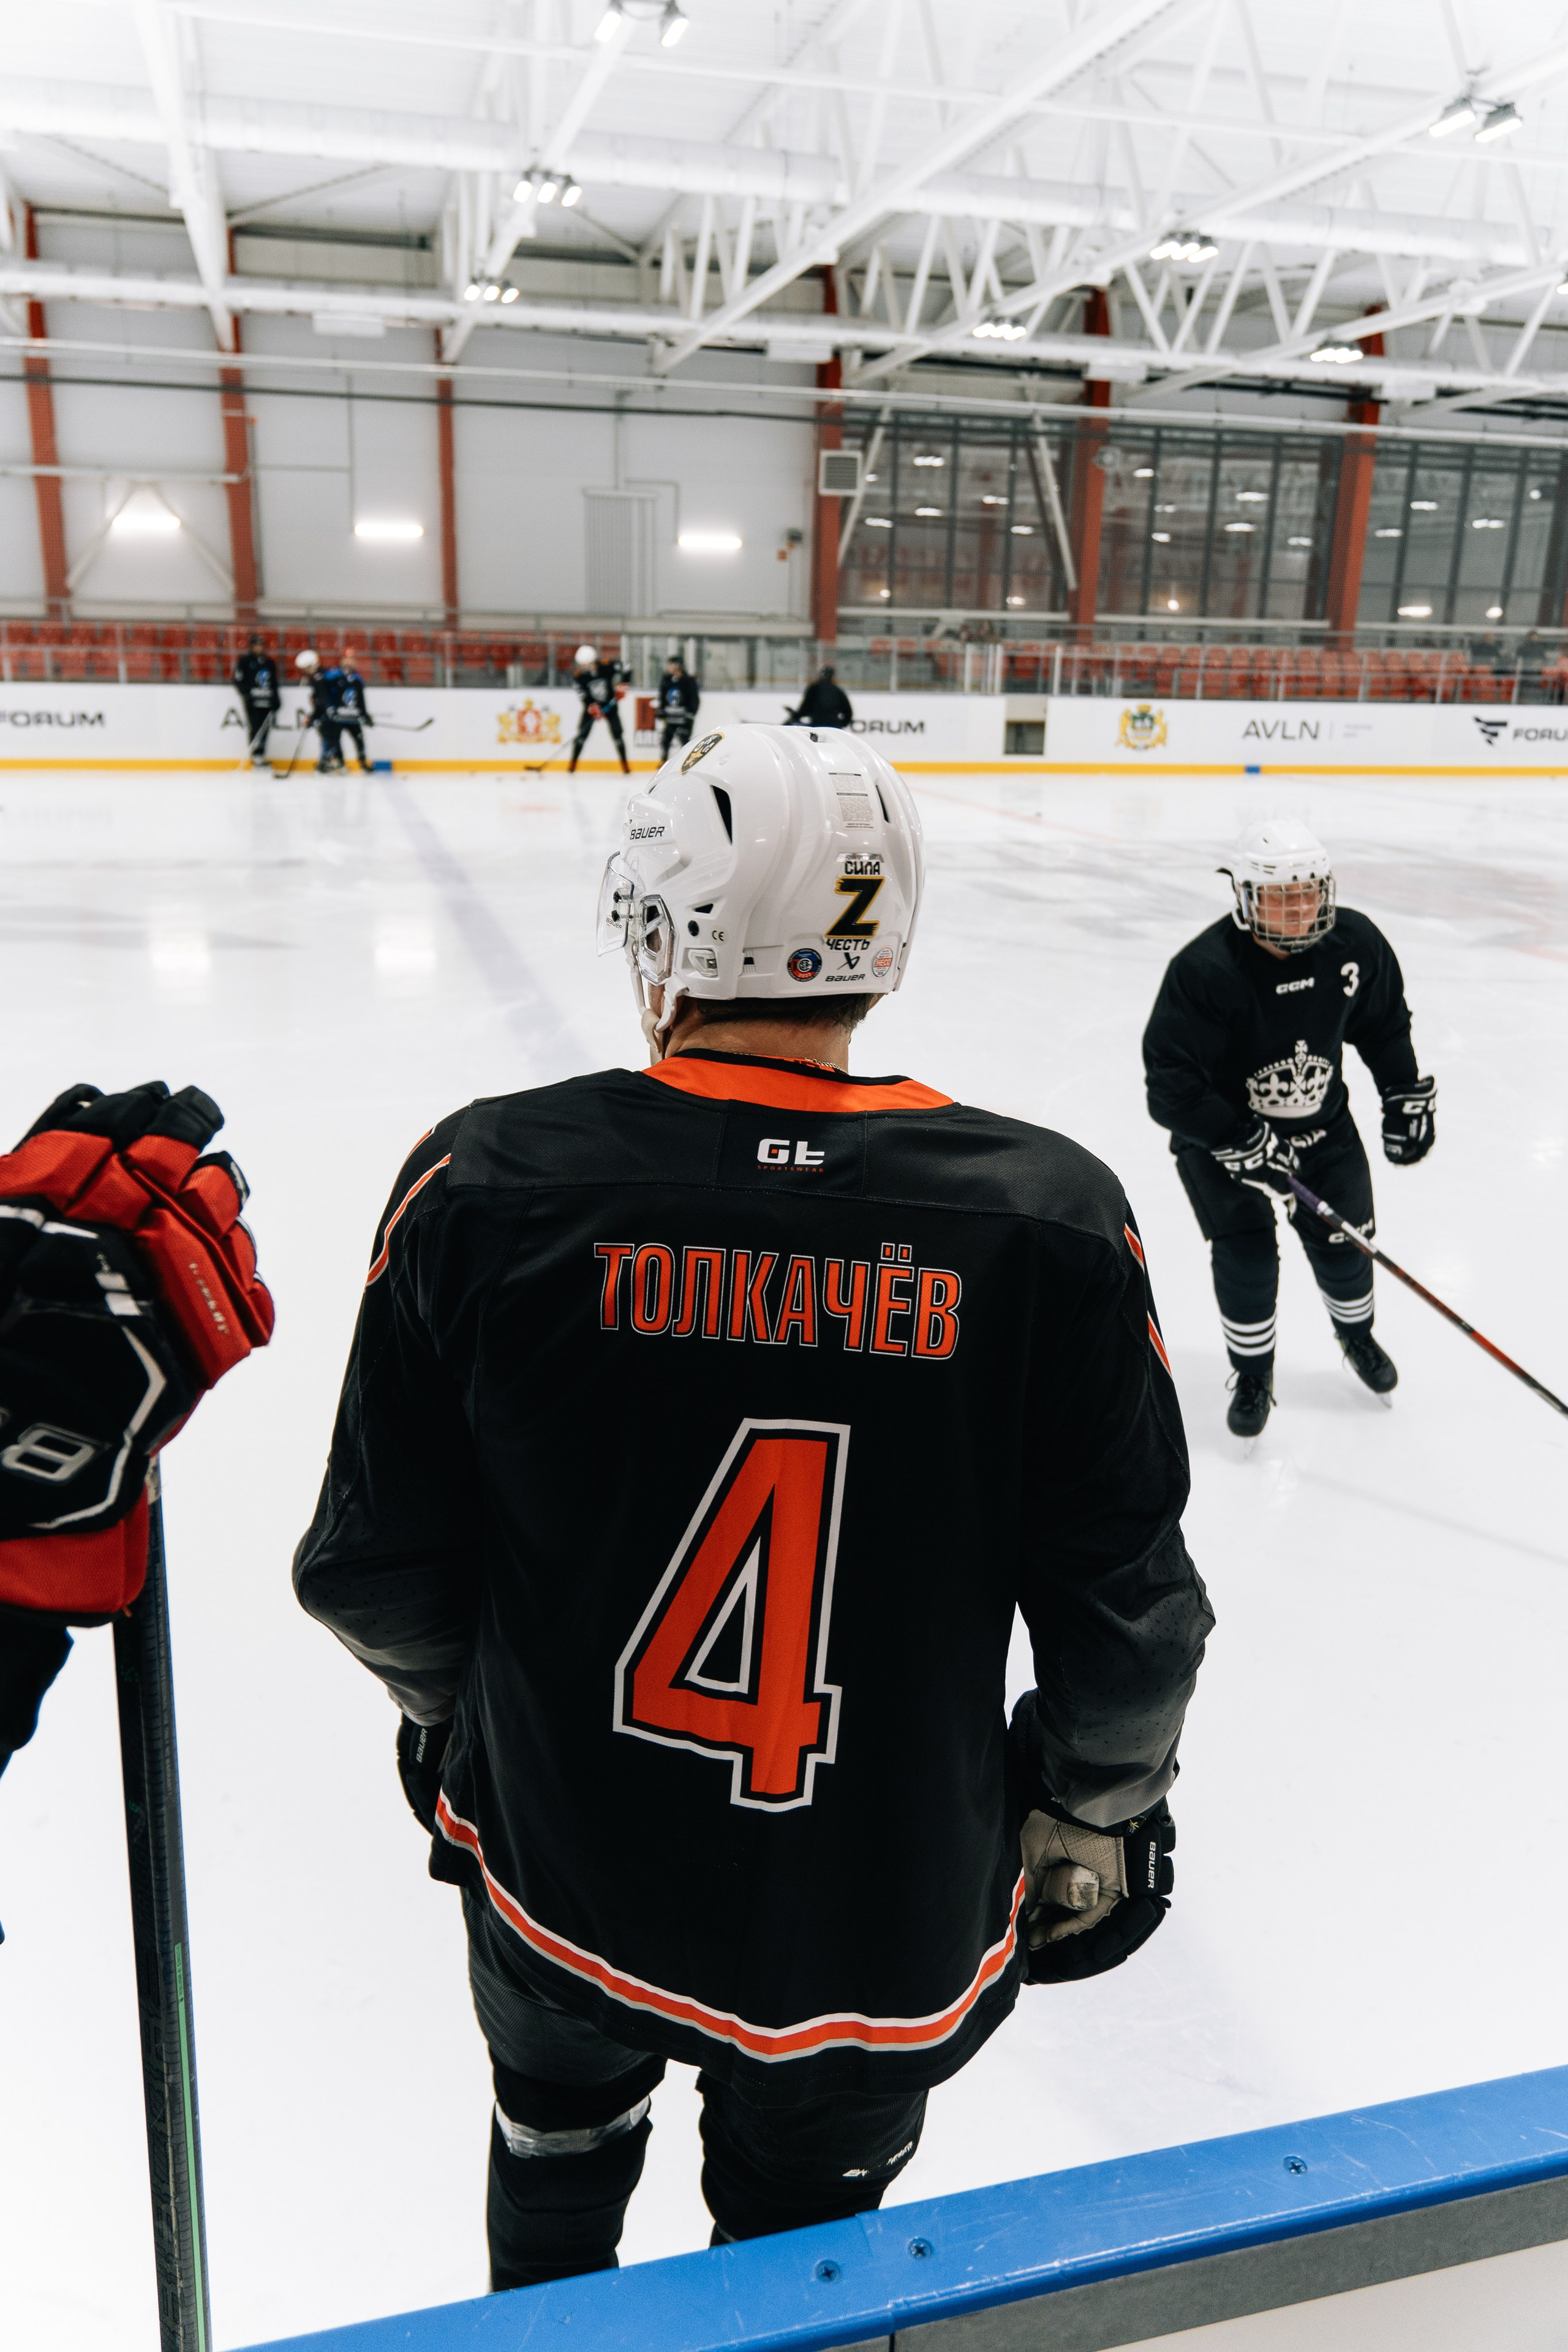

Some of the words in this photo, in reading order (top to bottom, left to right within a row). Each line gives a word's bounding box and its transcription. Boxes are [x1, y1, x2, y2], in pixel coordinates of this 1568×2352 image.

[851, 719, 924, 733] ORUM
[1242, 720, 1320, 740] AVLN
[1513, 728, 1568, 741] FORU
[630, 826, 665, 840] BAUER
[845, 861, 880, 875] СИЛА
[824, 876, 886, 939] Z
[712, 930, 725, 941] CE
[826, 938, 870, 951] ЧЕСТЬ
[1276, 978, 1314, 995] CCM
[1341, 962, 1360, 997] 3
[757, 1164, 824, 1173] SPORTSWEAR
[594, 1243, 962, 1360] ТОЛКАЧЁВ
[613, 1417, 851, 1812] 4
[416, 1727, 428, 1763] BAUER
[1147, 1841, 1156, 1889] BAUER
